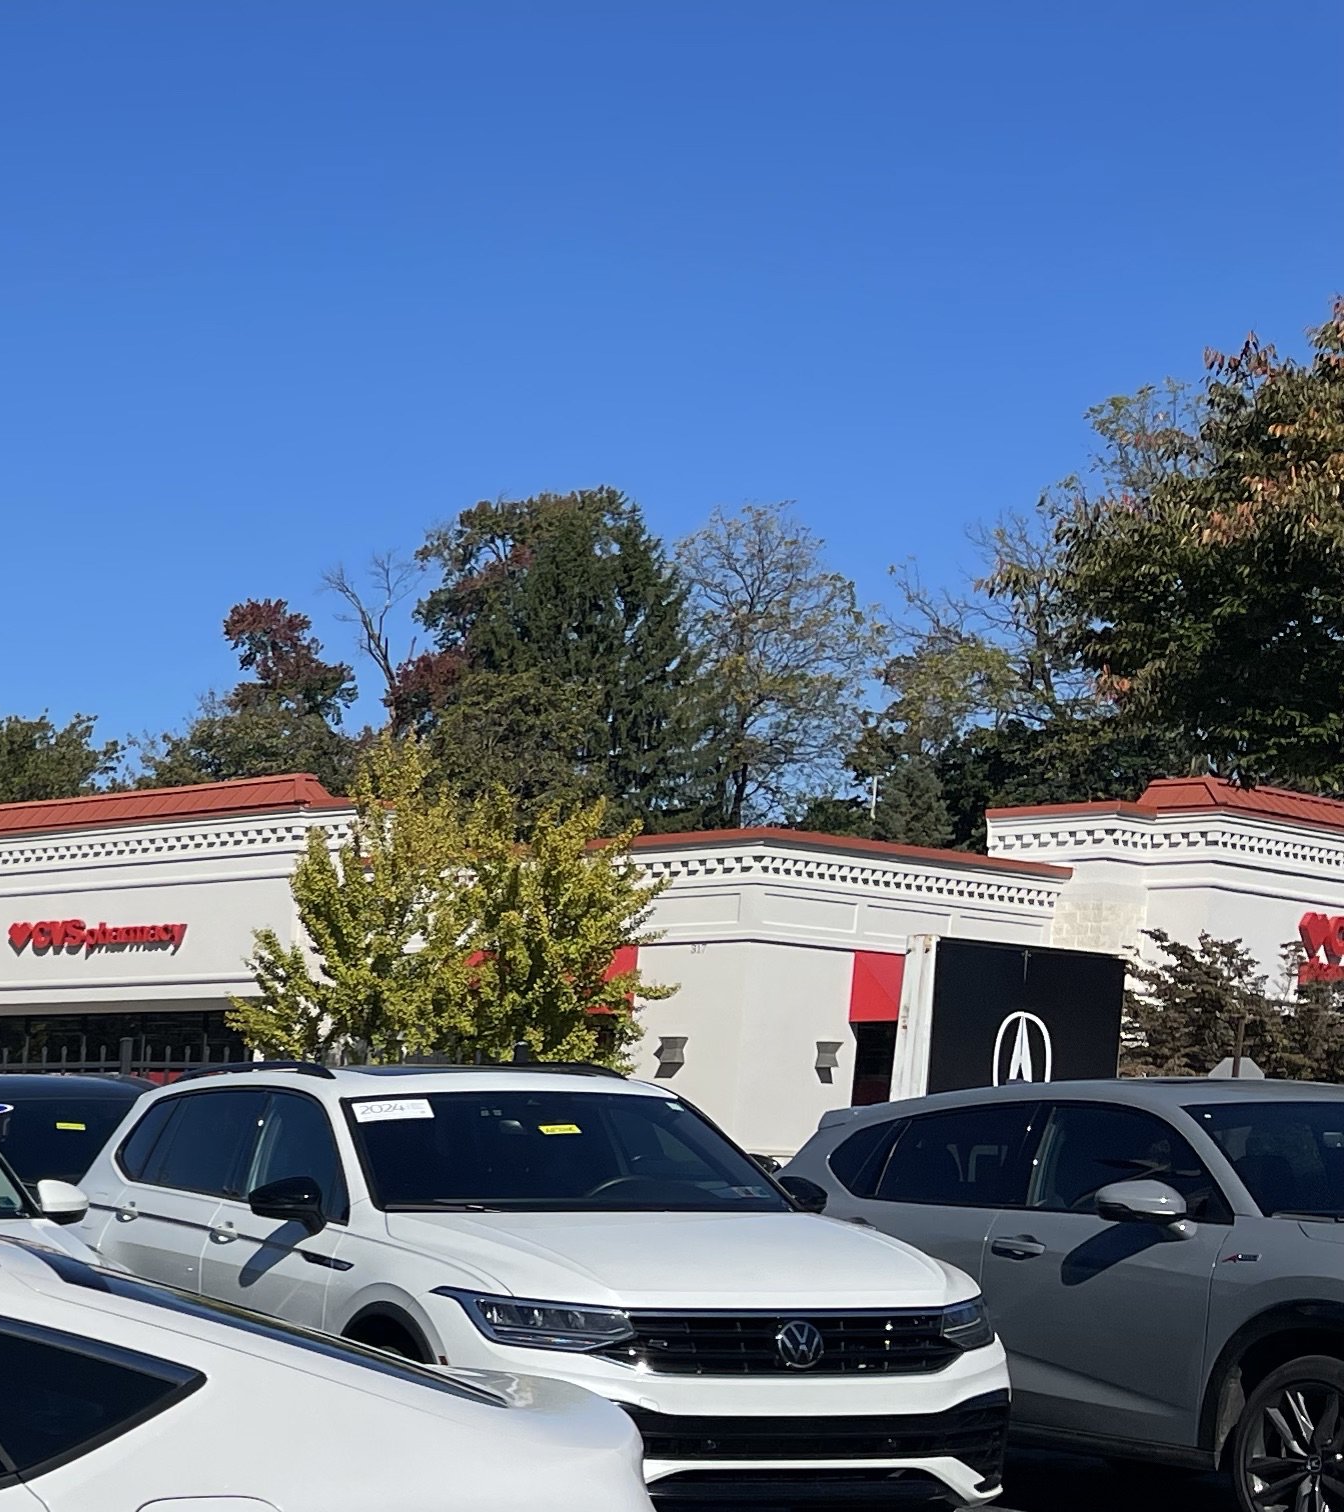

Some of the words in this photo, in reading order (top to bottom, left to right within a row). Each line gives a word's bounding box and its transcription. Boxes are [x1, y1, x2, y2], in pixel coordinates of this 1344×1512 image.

[32, 919, 87, 951] CVS
[84, 921, 189, 953] pharmacy
[359, 1103, 405, 1116] 2024
